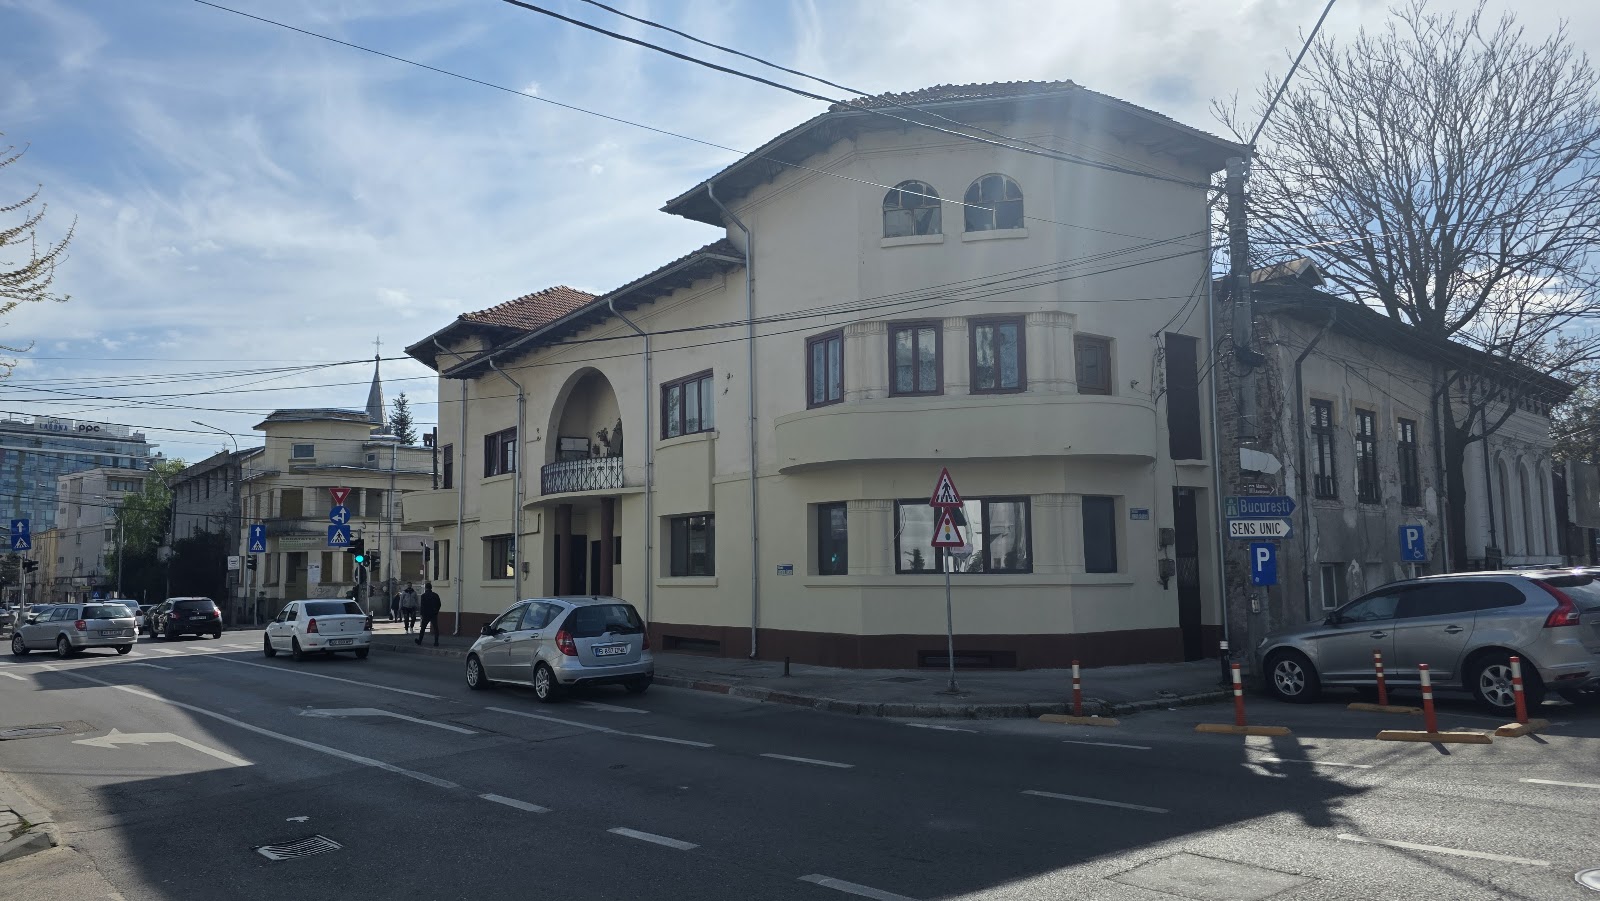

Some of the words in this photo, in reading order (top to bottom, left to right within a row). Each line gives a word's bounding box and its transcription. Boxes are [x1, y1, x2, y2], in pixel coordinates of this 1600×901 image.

[78, 424, 100, 433] ppc
[1240, 499, 1290, 515] București
[1231, 522, 1256, 535] SENS
[1259, 522, 1281, 535] UNIC
[1406, 528, 1419, 550] P
[1256, 547, 1270, 572] P
